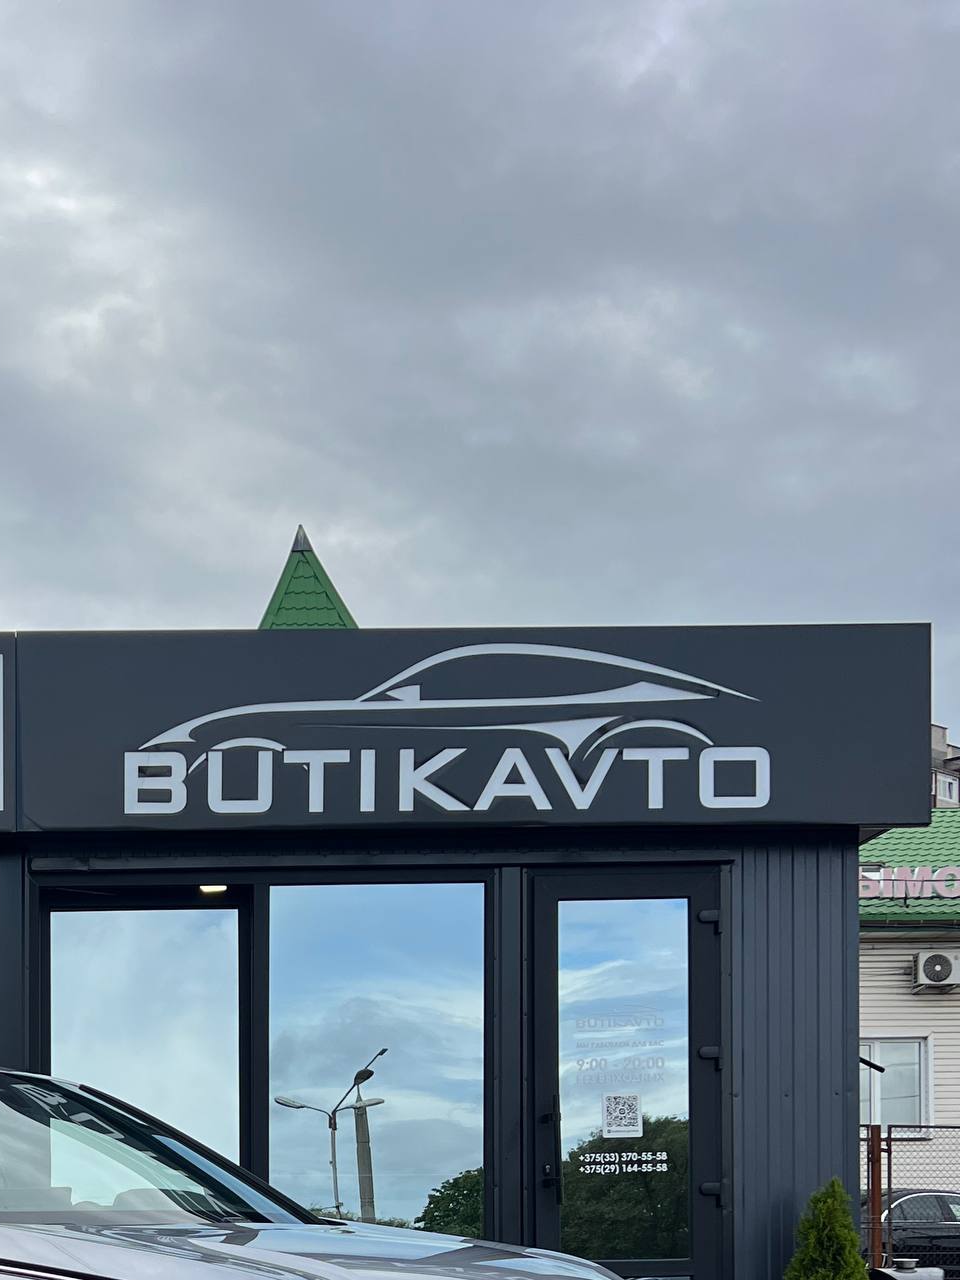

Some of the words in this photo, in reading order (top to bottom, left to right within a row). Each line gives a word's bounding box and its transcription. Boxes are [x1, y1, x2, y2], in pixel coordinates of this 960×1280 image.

[123, 746, 771, 815] BUTIKAVTO
[577, 1058, 608, 1071] 9:00
[624, 1056, 665, 1070] 20:00
[578, 1153, 620, 1163] +375(33)
[621, 1151, 668, 1162] 370-55-58
[578, 1164, 620, 1175] +375(29)
[622, 1162, 668, 1173] 164-55-58
